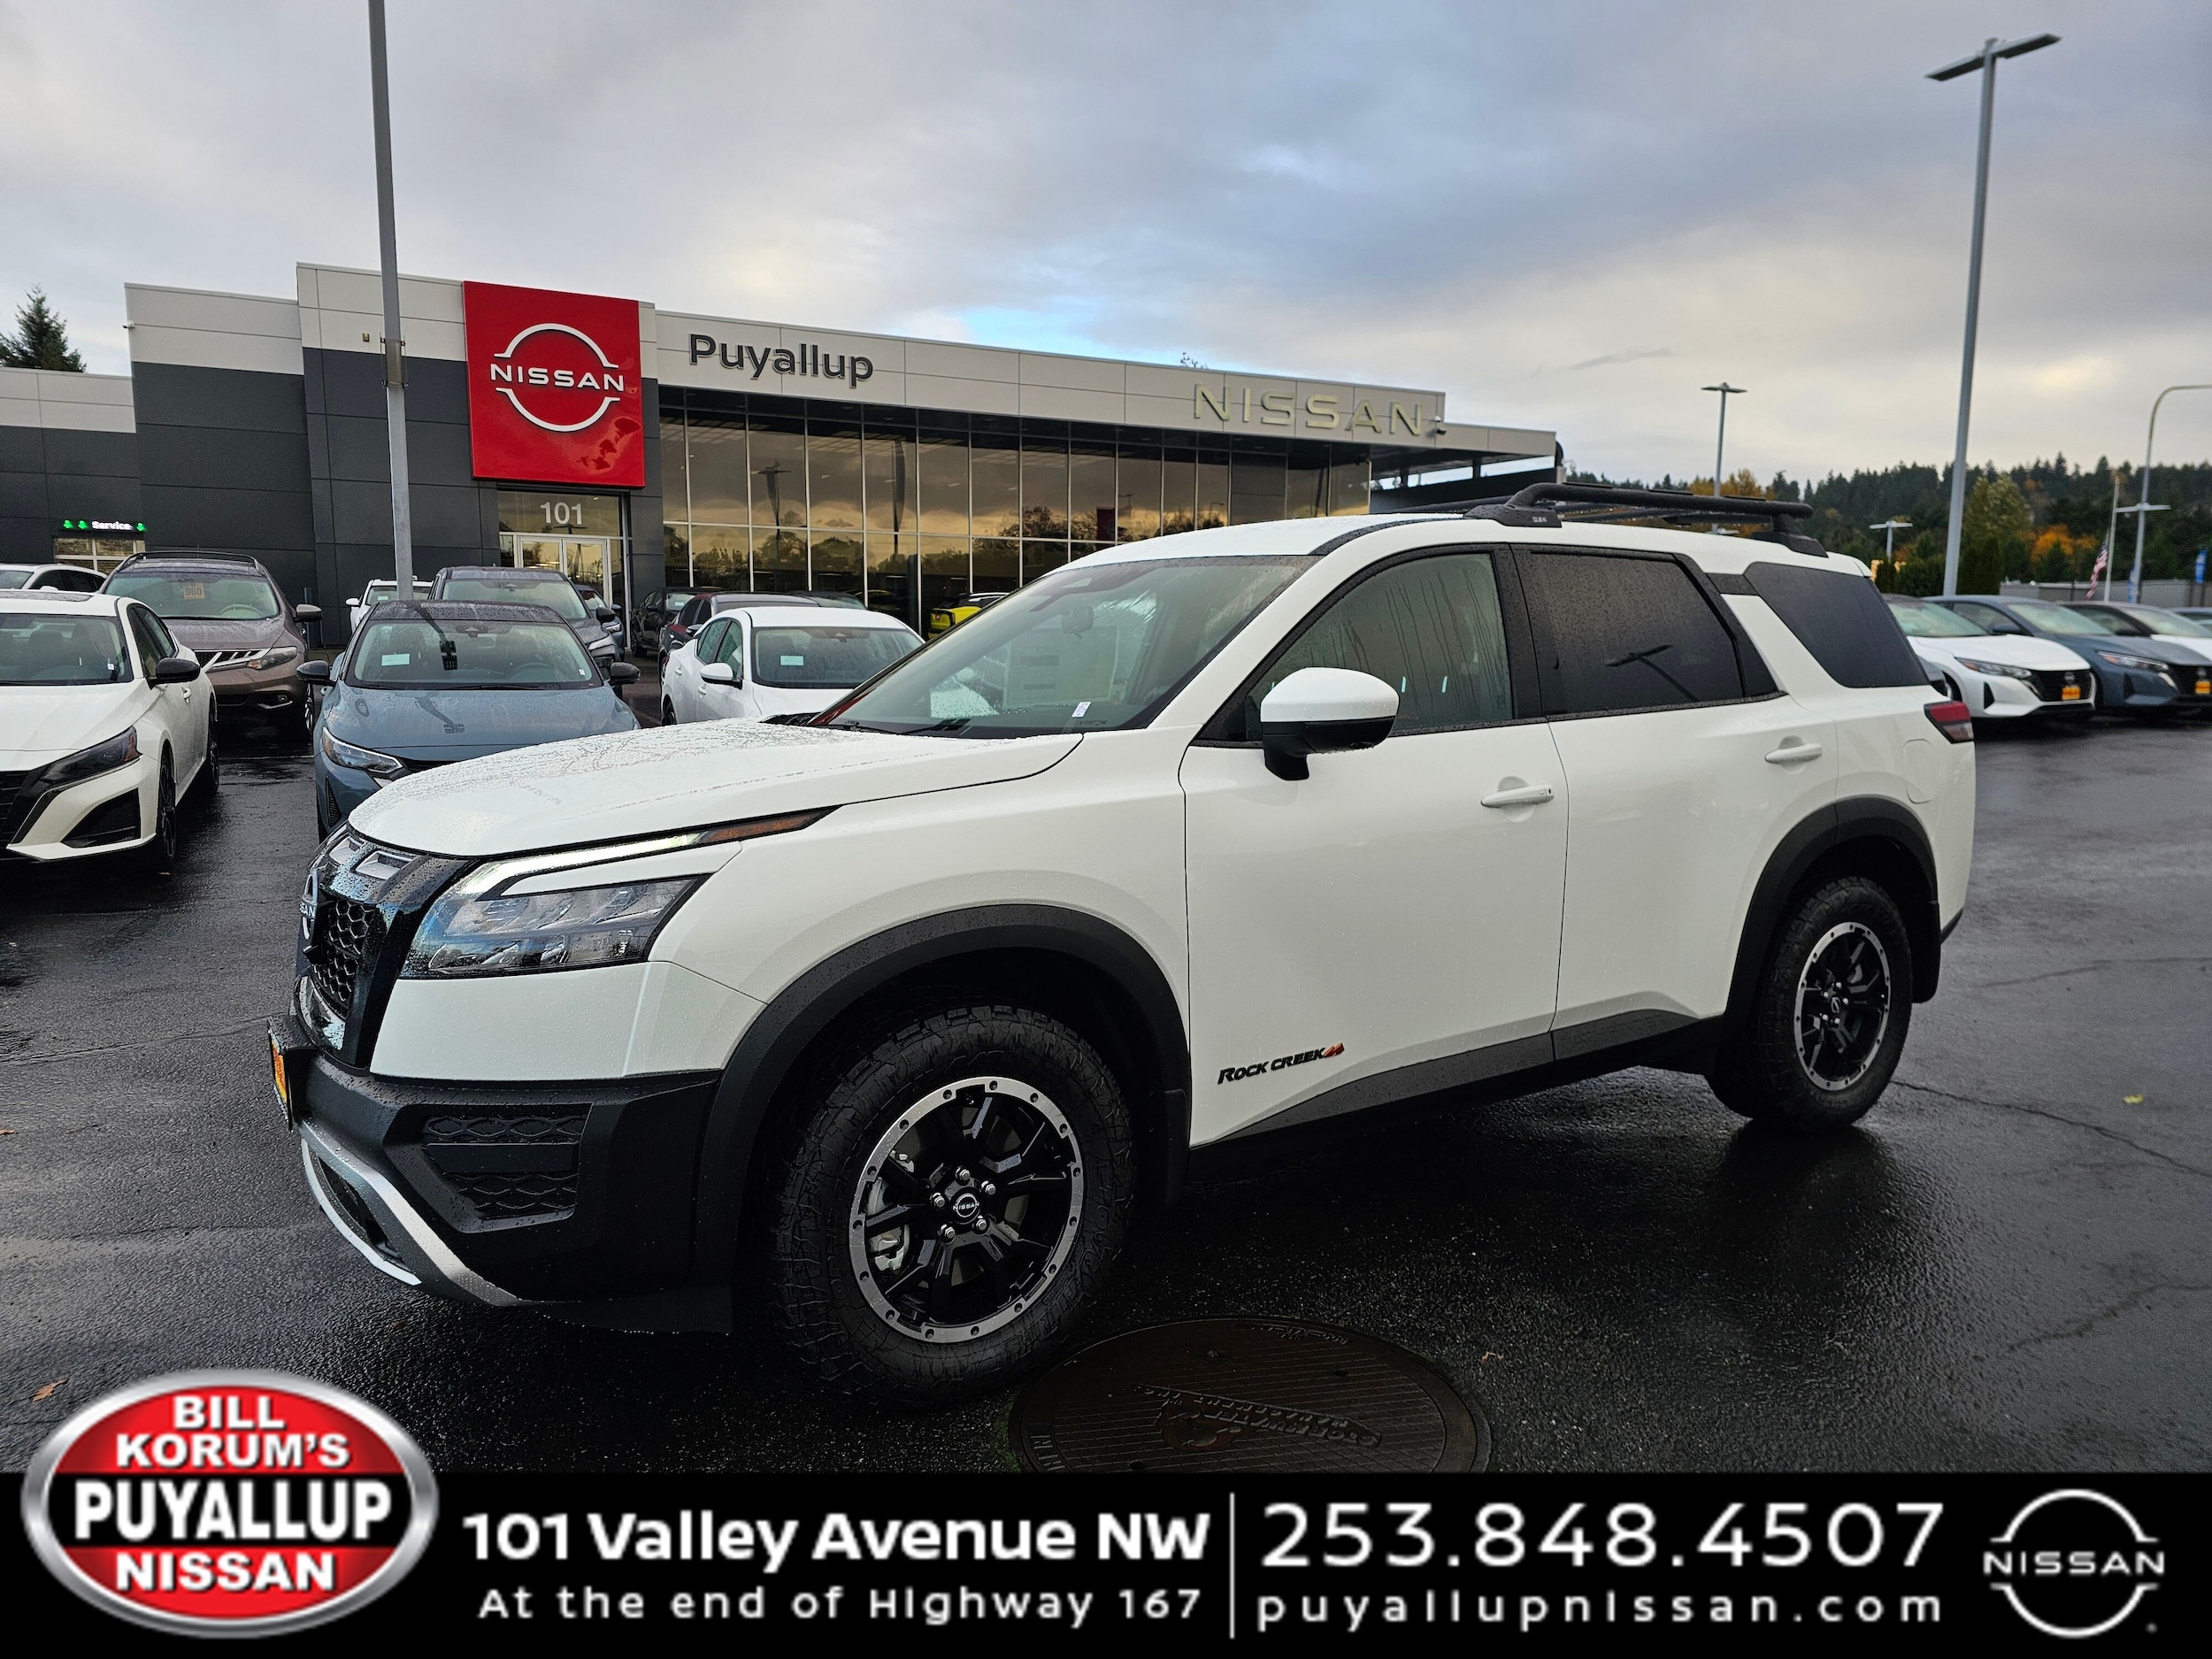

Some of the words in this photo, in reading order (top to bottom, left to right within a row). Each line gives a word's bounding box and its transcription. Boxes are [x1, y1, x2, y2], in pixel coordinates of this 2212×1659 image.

[689, 334, 873, 388] Puyallup
[490, 364, 624, 392] NISSAN
[1194, 383, 1422, 436] NISSAN
[91, 520, 133, 531] Service
[540, 502, 583, 526] 101
[1271, 1047, 1326, 1071] CREEK
[952, 1202, 980, 1211] NISSAN
